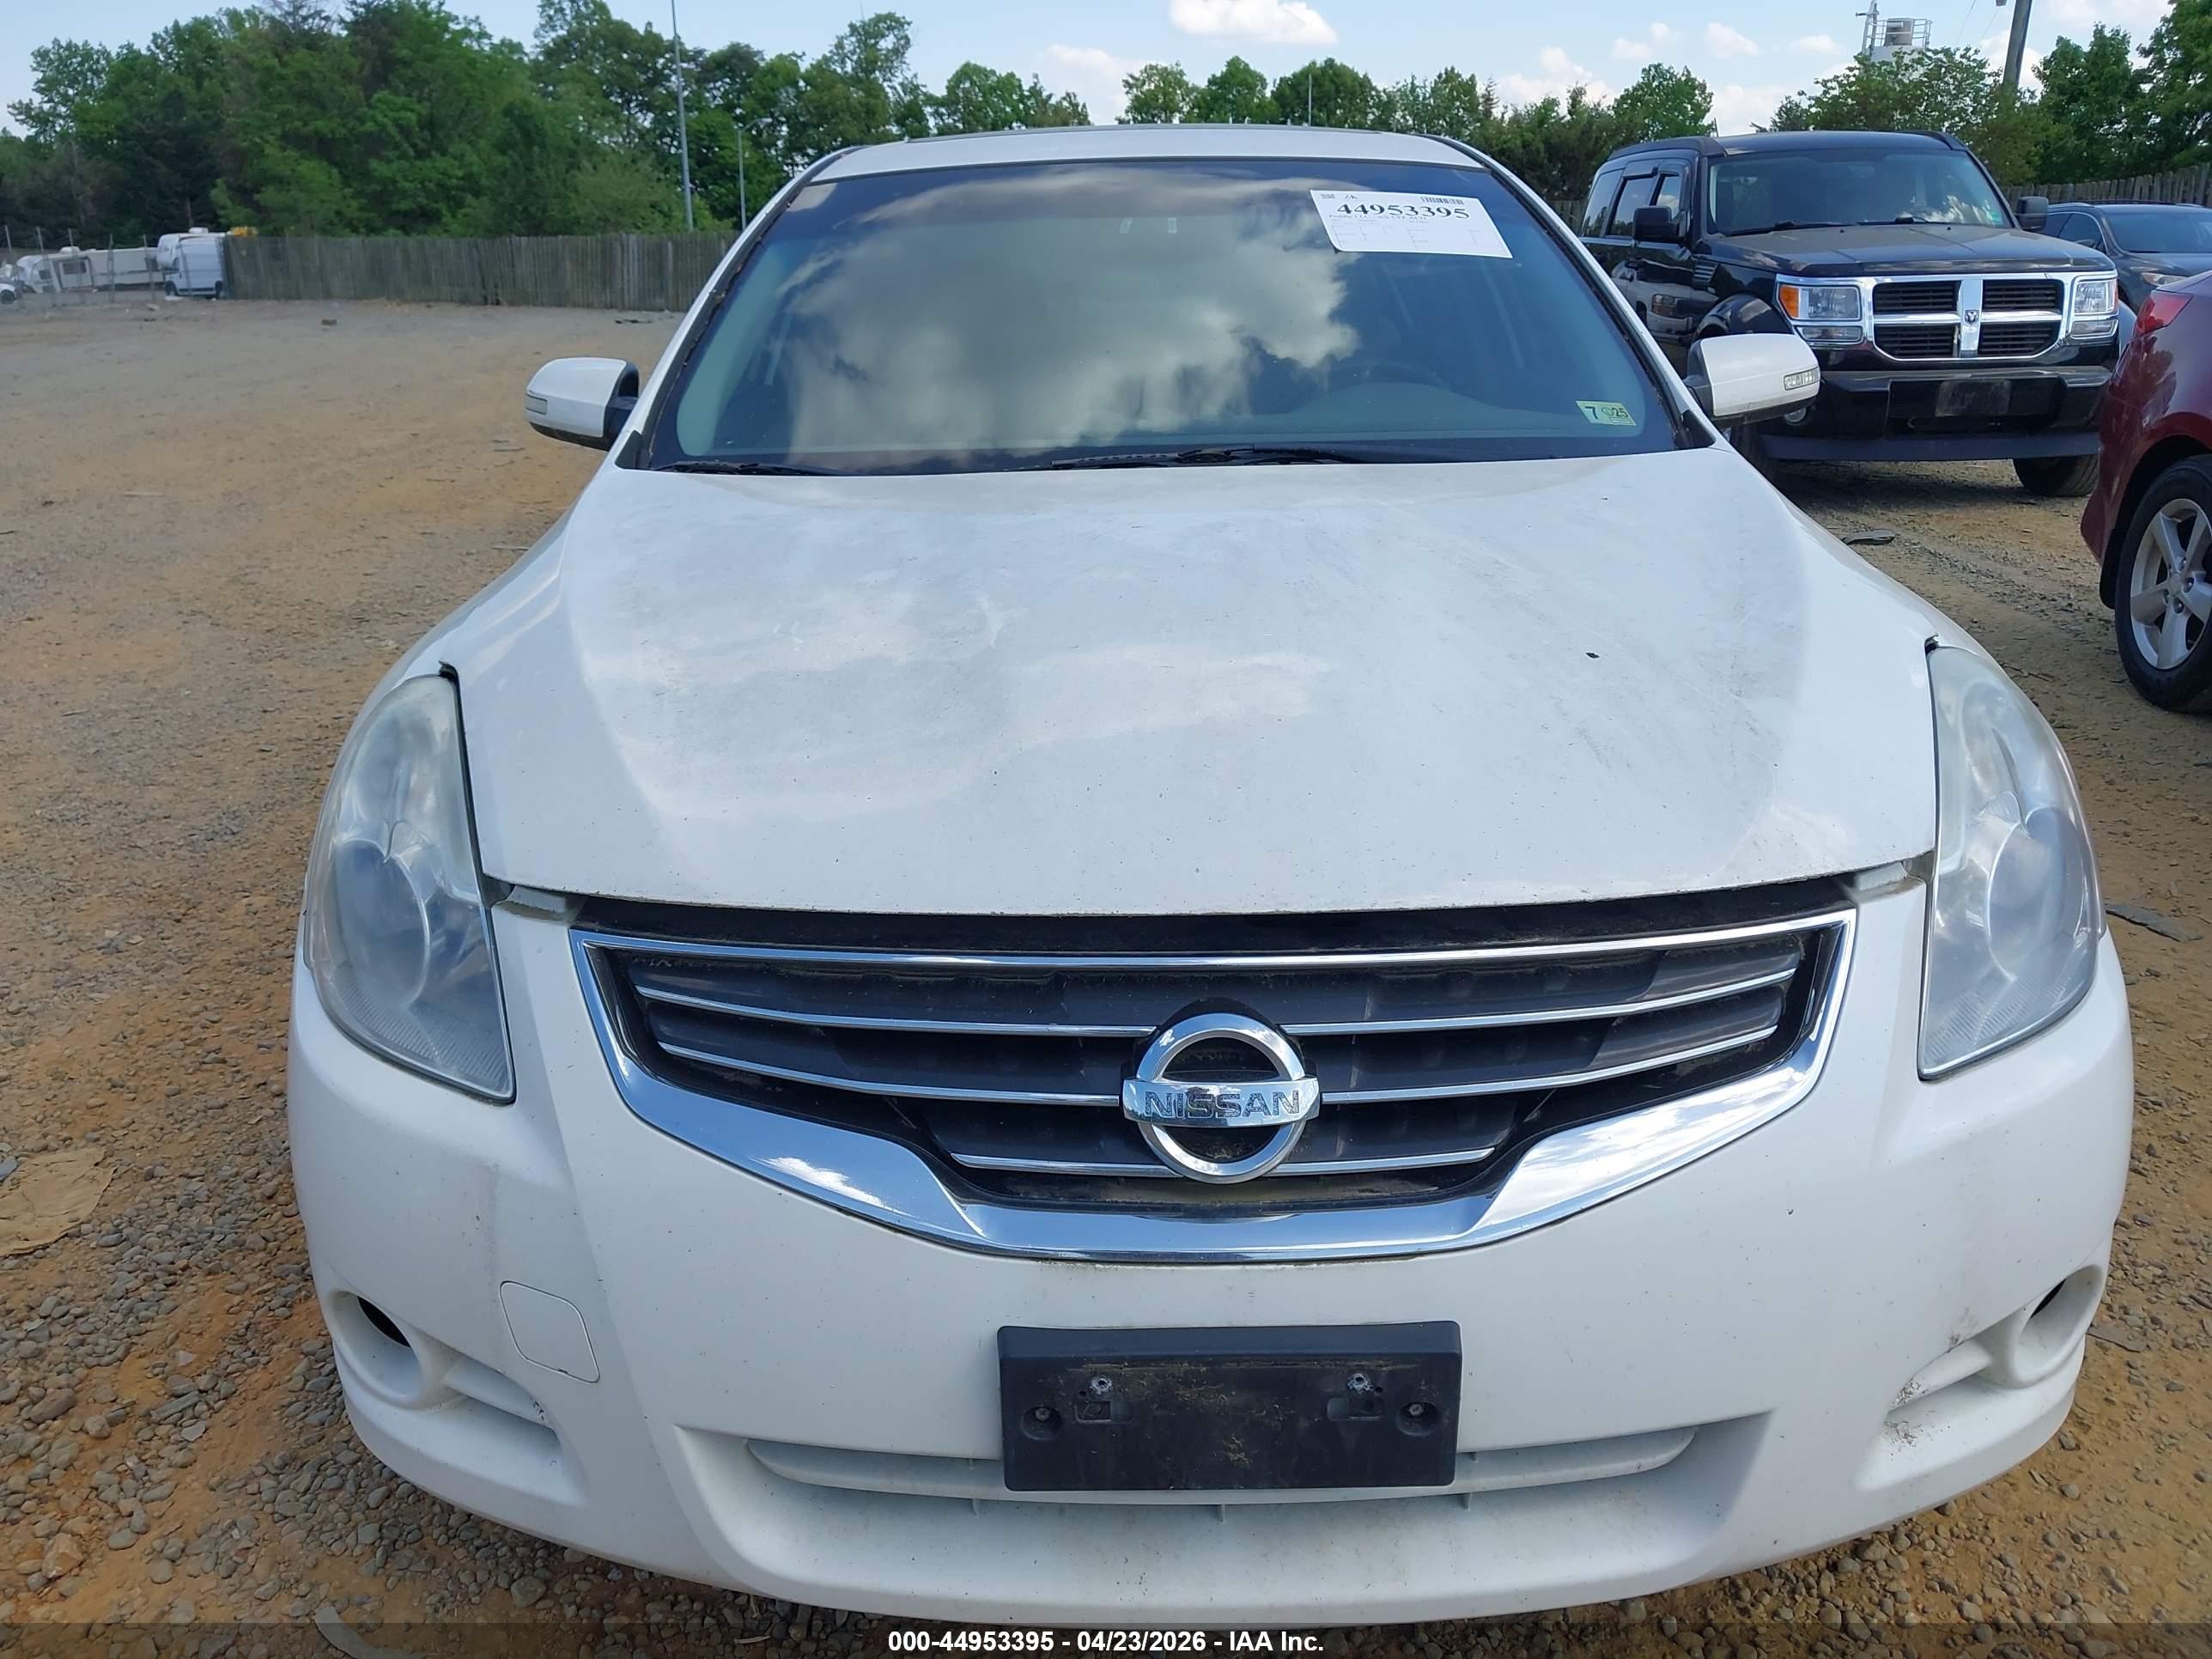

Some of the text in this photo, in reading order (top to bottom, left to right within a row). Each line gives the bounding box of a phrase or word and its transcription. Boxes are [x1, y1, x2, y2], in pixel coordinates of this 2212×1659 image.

[1337, 204, 1470, 219] 44953395
[1584, 406, 1598, 419] 7
[1145, 1090, 1299, 1118] NISSAN
